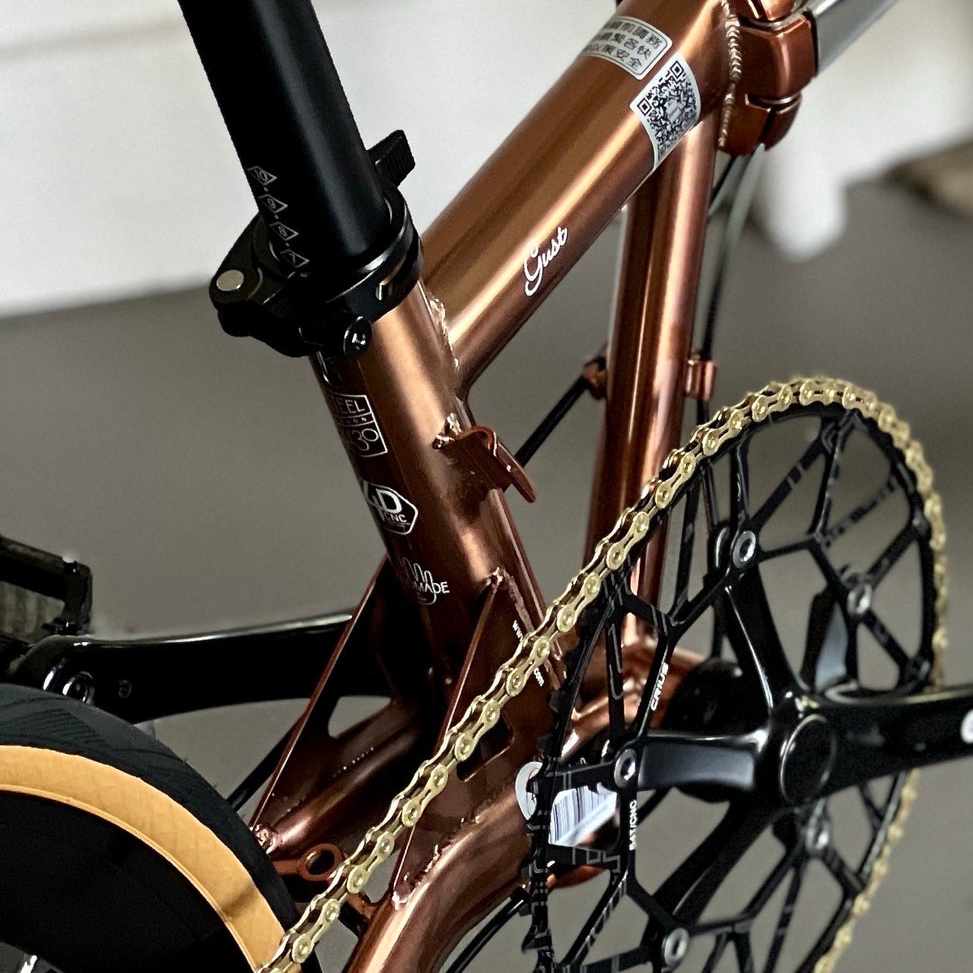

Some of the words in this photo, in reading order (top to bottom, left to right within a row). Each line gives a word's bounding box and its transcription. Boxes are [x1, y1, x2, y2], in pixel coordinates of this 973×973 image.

[523, 226, 568, 297] Gust
[328, 396, 366, 416] TEEL
[651, 661, 669, 711] CRIUS
